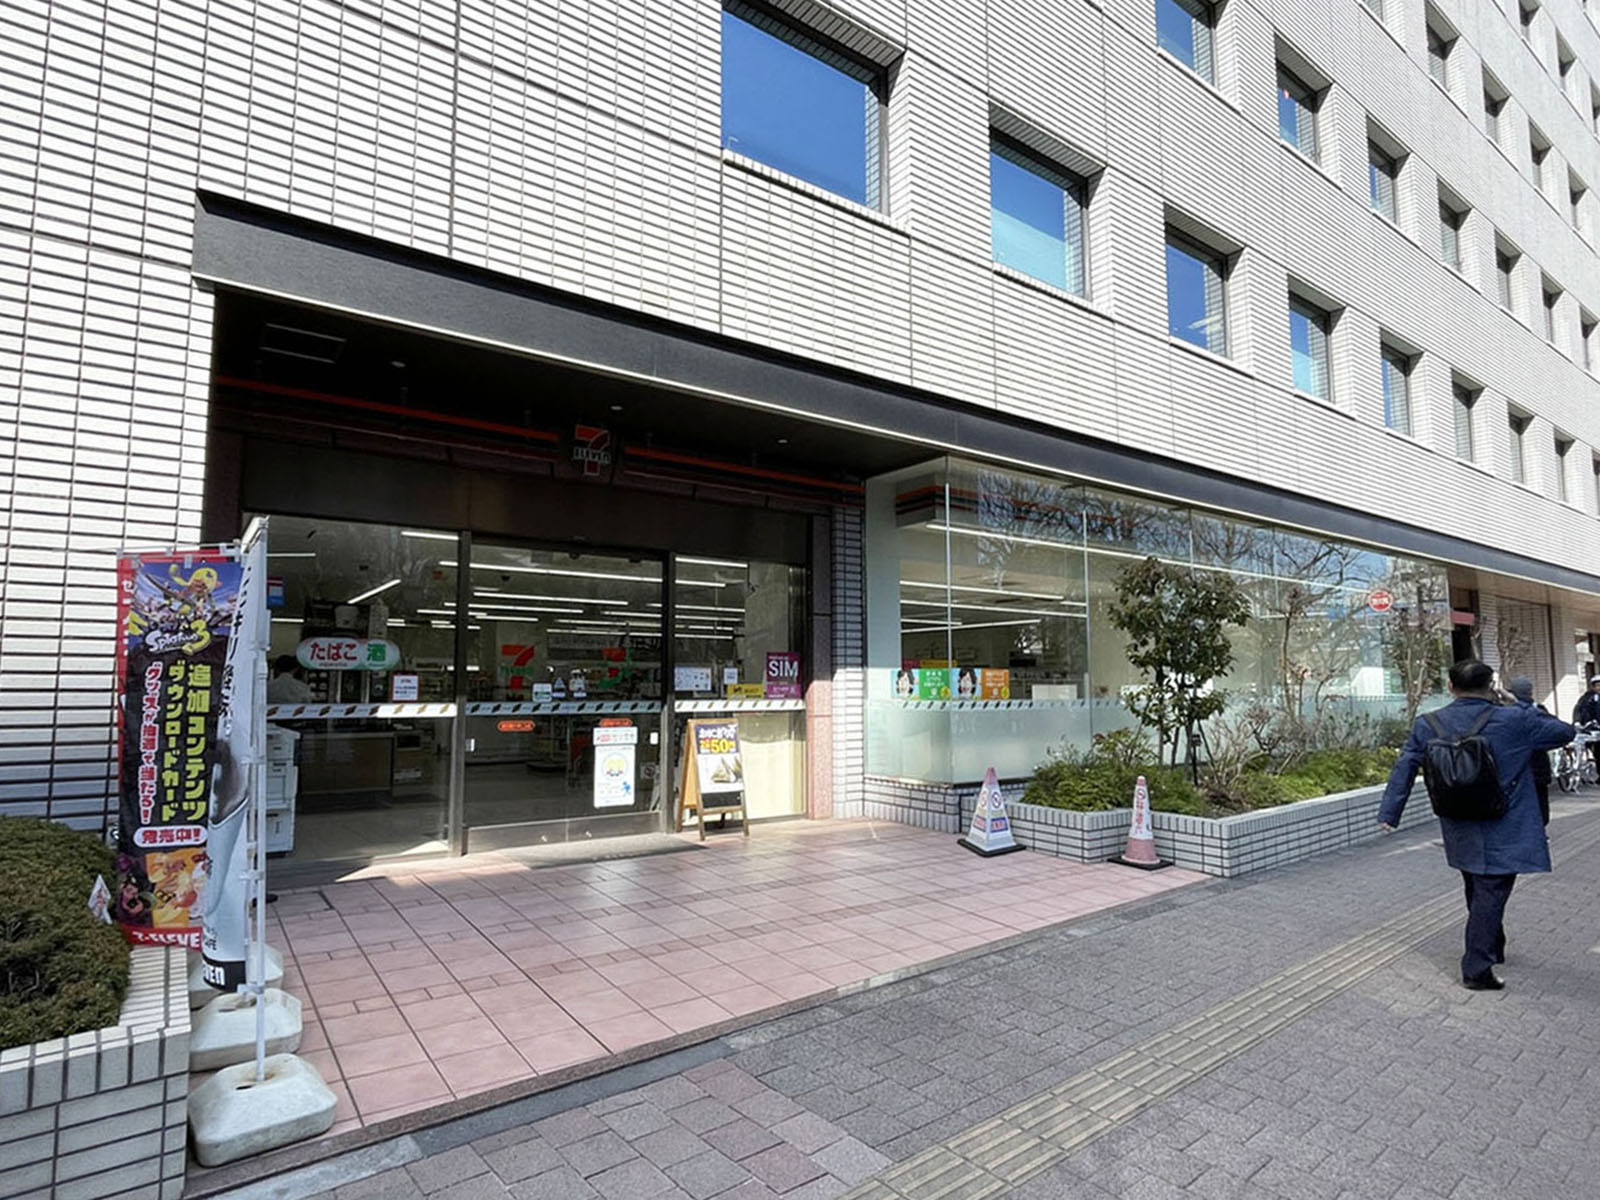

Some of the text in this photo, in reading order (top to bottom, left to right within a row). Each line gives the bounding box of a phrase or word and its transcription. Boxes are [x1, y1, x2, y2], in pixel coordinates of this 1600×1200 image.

[310, 641, 386, 662] たばこ 酒
[768, 660, 799, 677] SIM
[162, 660, 185, 822] ダウンロードカード
[183, 664, 211, 820] 追加コンテンツ
[132, 930, 200, 949] 7-ELEVE
